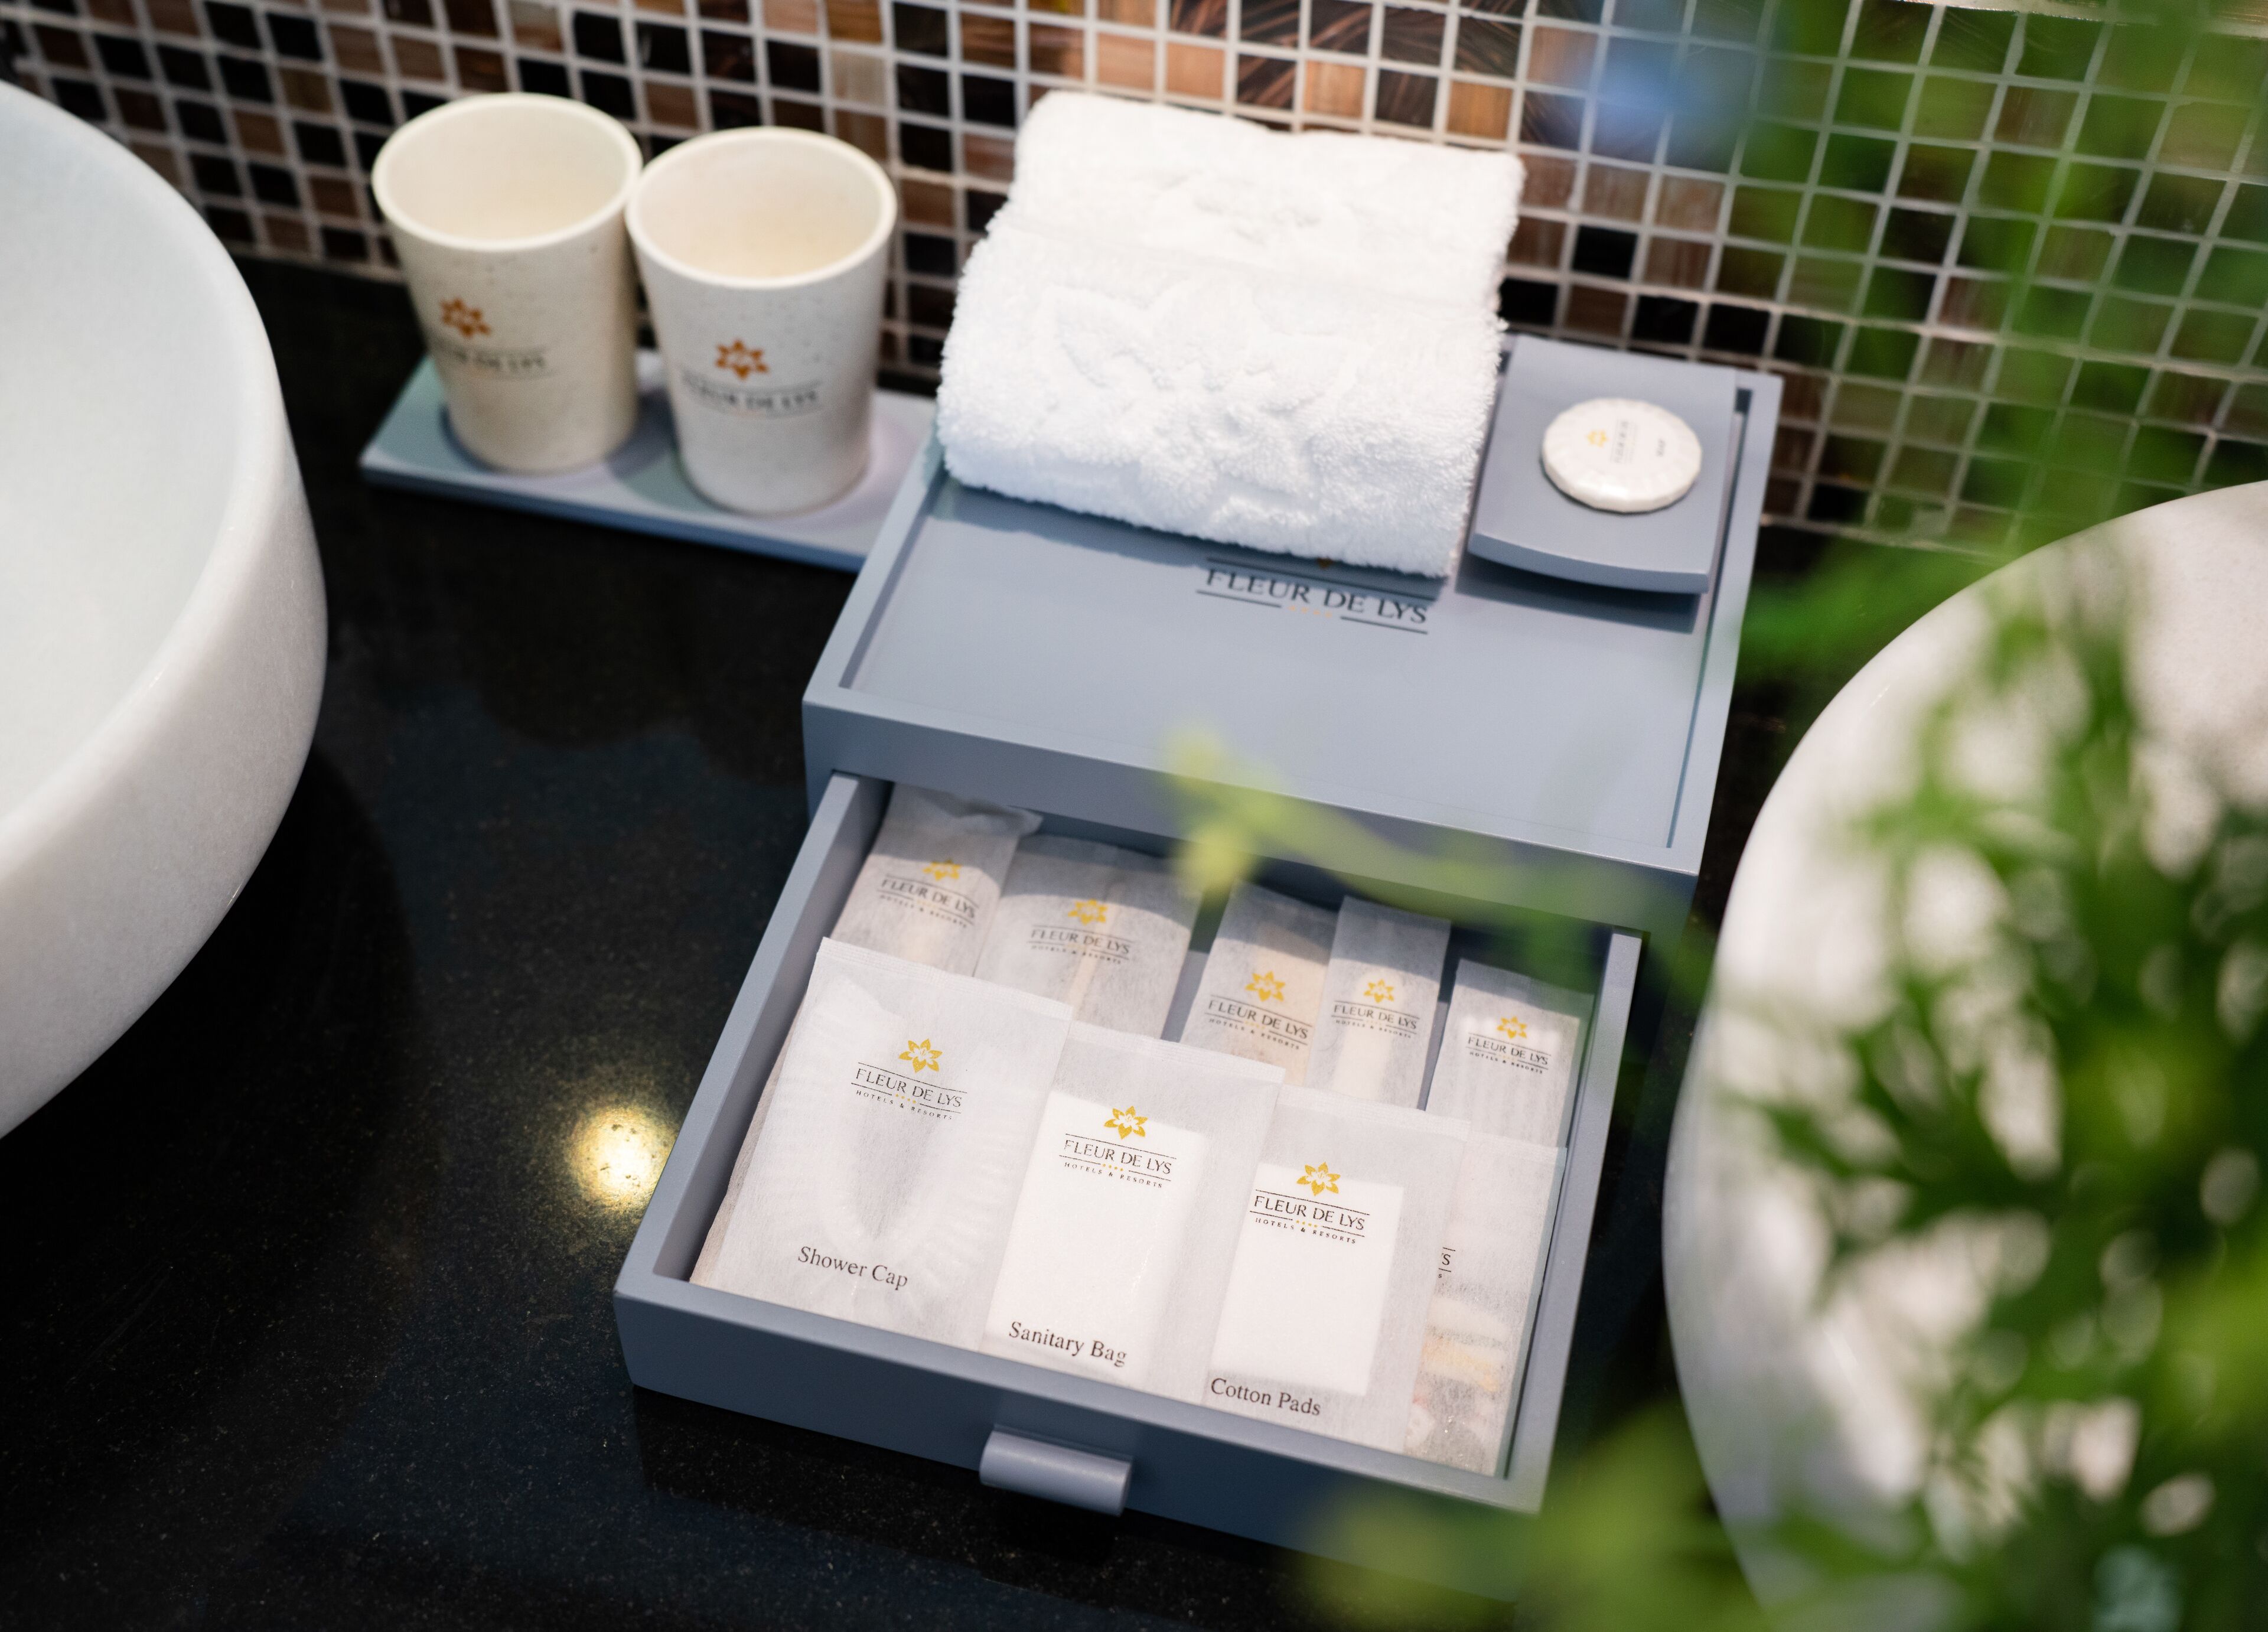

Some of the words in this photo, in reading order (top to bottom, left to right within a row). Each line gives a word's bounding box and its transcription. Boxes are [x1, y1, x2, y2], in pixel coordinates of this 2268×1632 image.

[1206, 569, 1311, 604] FLEUR
[1324, 589, 1367, 613] DE
[1377, 598, 1429, 624] LYS
[881, 879, 928, 898] FLEUR
[931, 891, 950, 905] DE
[955, 899, 975, 918] LYS
[1031, 929, 1079, 943] FLEUR
[1083, 935, 1103, 947] DE
[1107, 940, 1131, 955] LYS
[1208, 999, 1257, 1021] FLEUR
[1262, 1014, 1282, 1030] DE
[1285, 1022, 1309, 1040] LYS
[1334, 1004, 1374, 1019] FLEUR
[1378, 1012, 1394, 1024] DE
[1398, 1017, 1418, 1030] LYS
[1468, 1036, 1507, 1054] FLEUR
[1510, 1047, 1526, 1059] DE
[1530, 1053, 1549, 1066] LYS
[856, 1068, 907, 1094] FLEUR
[912, 1086, 934, 1102] DE
[937, 1092, 962, 1108] LYS
[856, 1090, 894, 1105] HOTELS
[911, 1106, 953, 1120] RESORTS
[1064, 1139, 1116, 1162] FLEUR
[1120, 1151, 1142, 1168] DE
[1146, 1157, 1172, 1175] LYS
[1064, 1162, 1103, 1175] HOTELS
[1120, 1174, 1162, 1188] RESORTS
[1254, 1195, 1307, 1217] FLEUR
[1312, 1207, 1335, 1223] DE
[1339, 1213, 1366, 1231] LYS
[1255, 1217, 1295, 1230] HOTELS
[1312, 1229, 1356, 1245] RESORTS
[798, 1246, 868, 1277] Shower
[872, 1265, 908, 1291] Cap
[1008, 1321, 1084, 1357] Sanitary
[1090, 1339, 1128, 1368] Bag
[1211, 1377, 1272, 1406] Cotton
[1278, 1391, 1321, 1416] Pads
